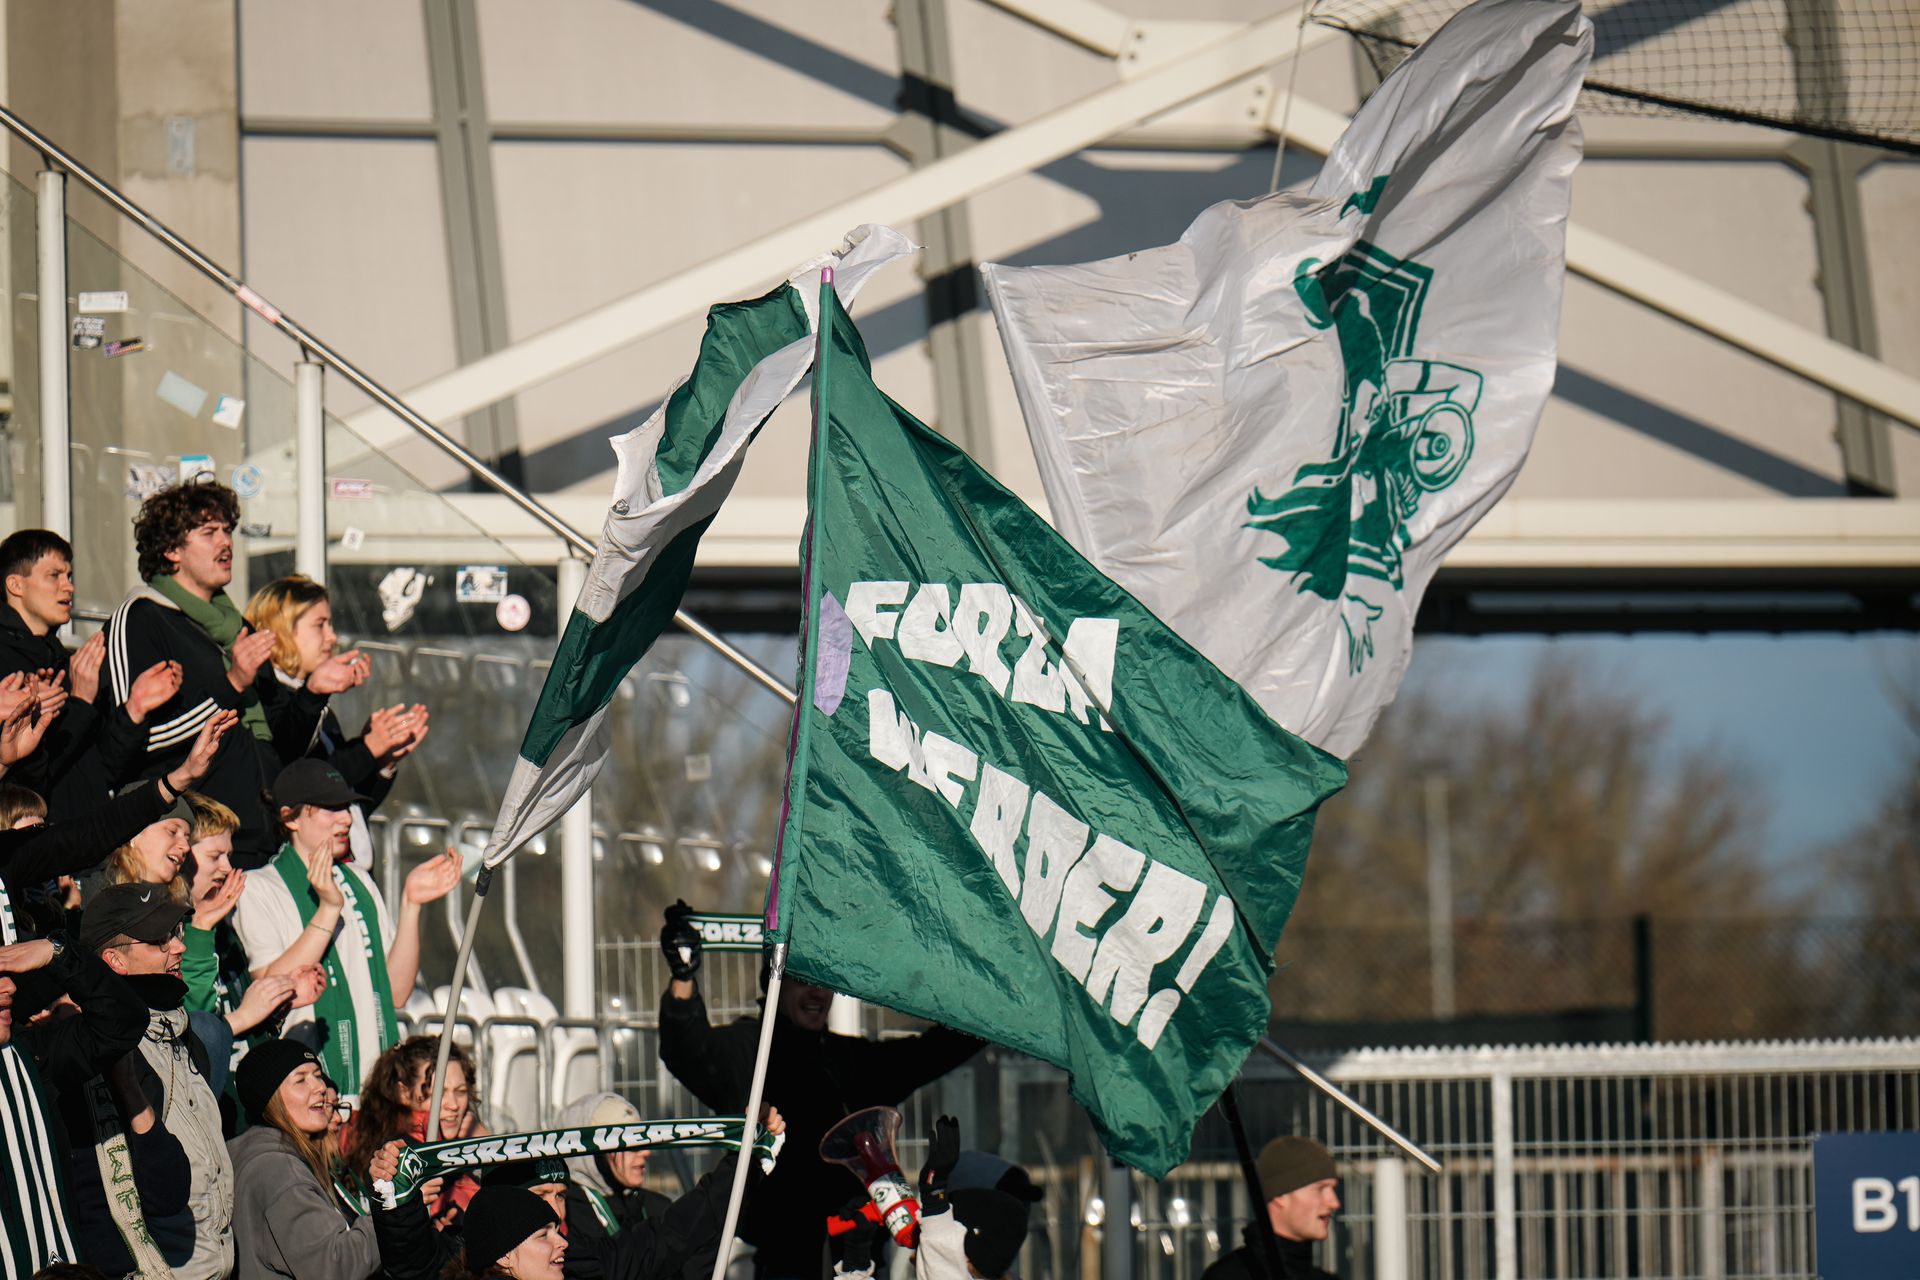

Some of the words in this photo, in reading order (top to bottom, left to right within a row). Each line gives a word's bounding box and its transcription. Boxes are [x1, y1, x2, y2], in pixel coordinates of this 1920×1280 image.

[845, 580, 1119, 732] FORZA
[868, 688, 1236, 1051] WERDER!
[1852, 1176, 1920, 1233] B1
